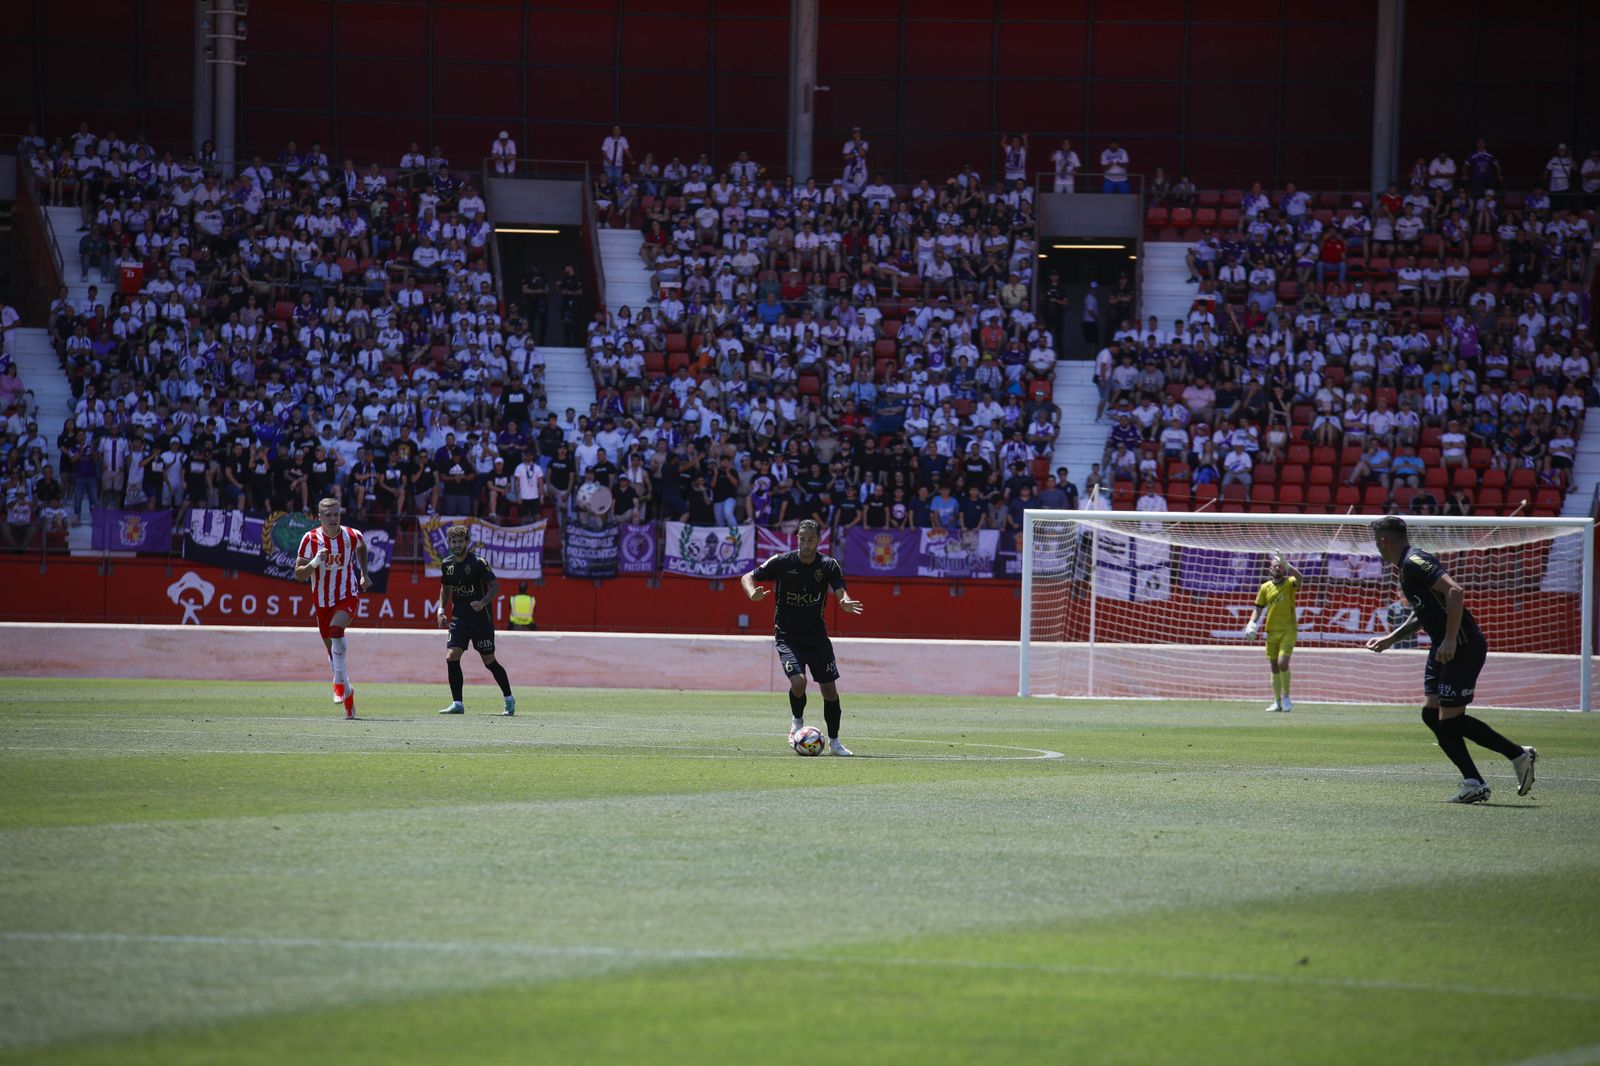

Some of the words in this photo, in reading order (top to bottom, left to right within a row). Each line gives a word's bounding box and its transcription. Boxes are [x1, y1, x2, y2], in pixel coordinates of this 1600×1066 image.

[446, 565, 454, 575] 20
[668, 559, 717, 574] YOUNG
[785, 660, 793, 673] 6
